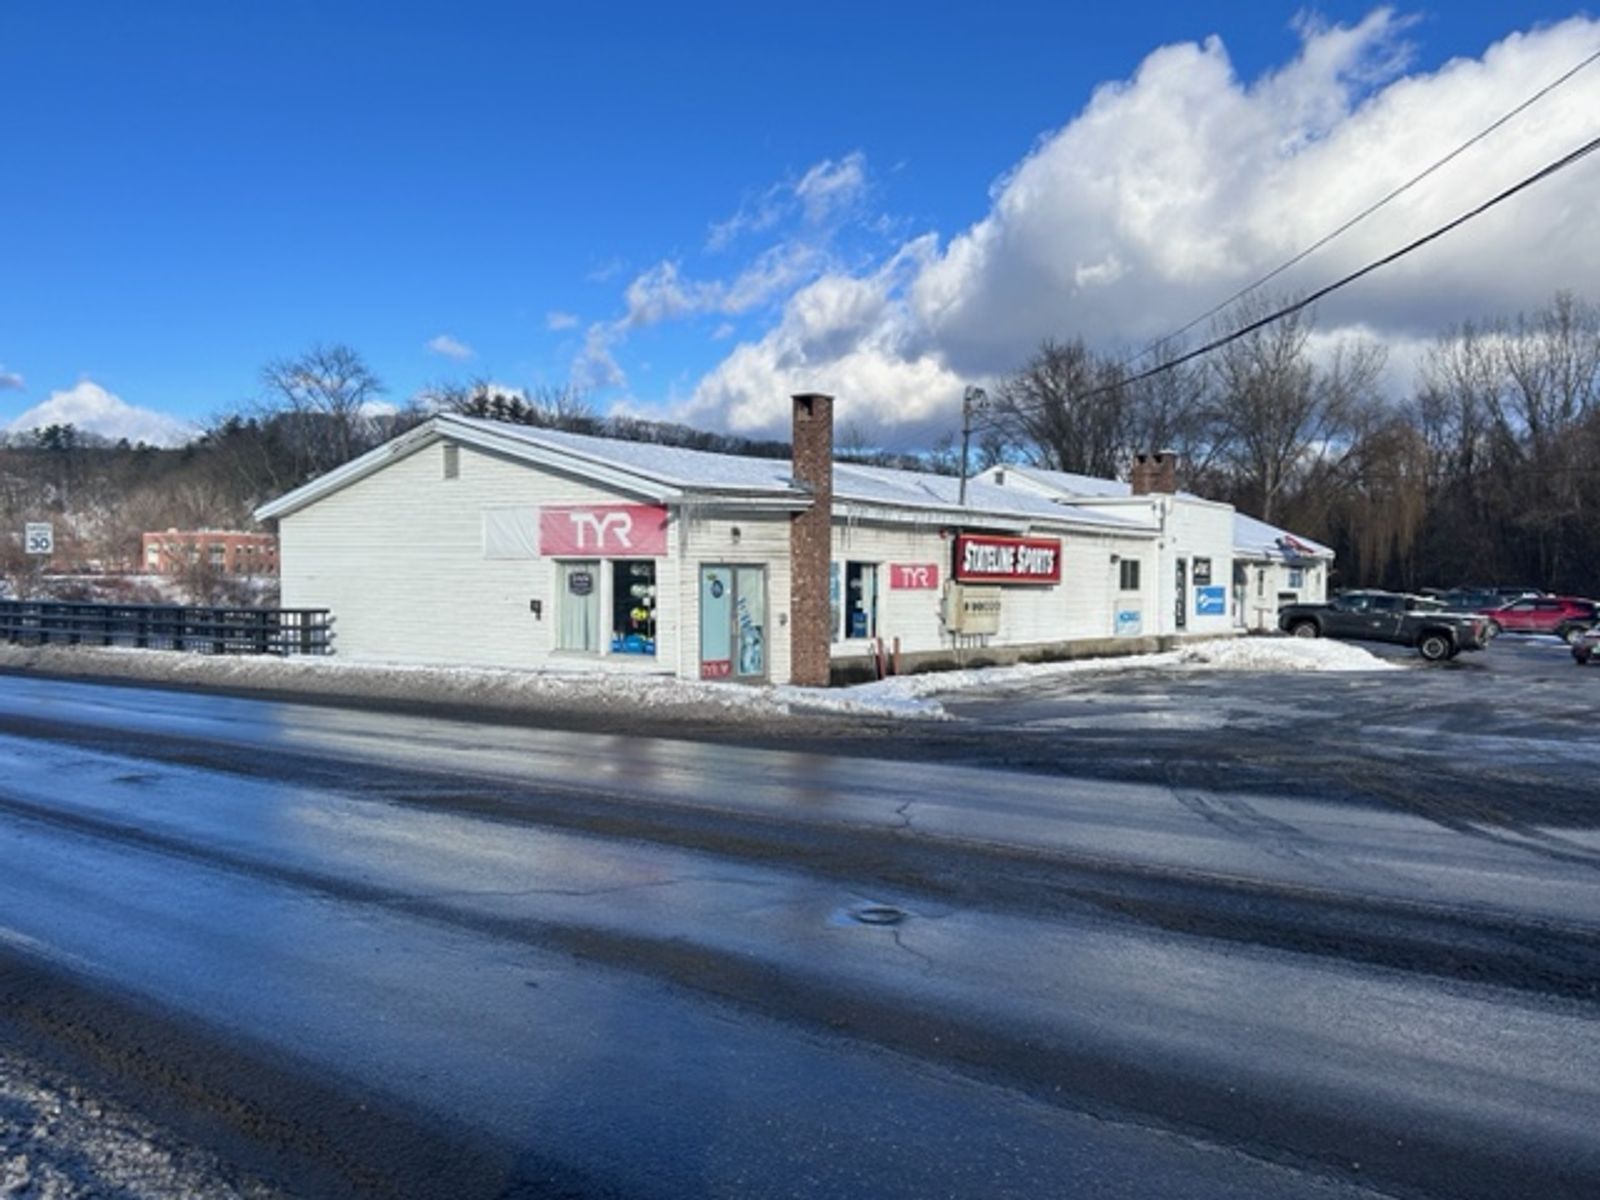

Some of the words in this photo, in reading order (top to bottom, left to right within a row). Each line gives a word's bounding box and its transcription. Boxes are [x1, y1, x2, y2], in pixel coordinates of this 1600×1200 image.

[570, 512, 632, 547] TYR
[30, 537, 49, 550] 30
[1016, 545, 1055, 574] SPORTS
[901, 568, 928, 587] TYR
